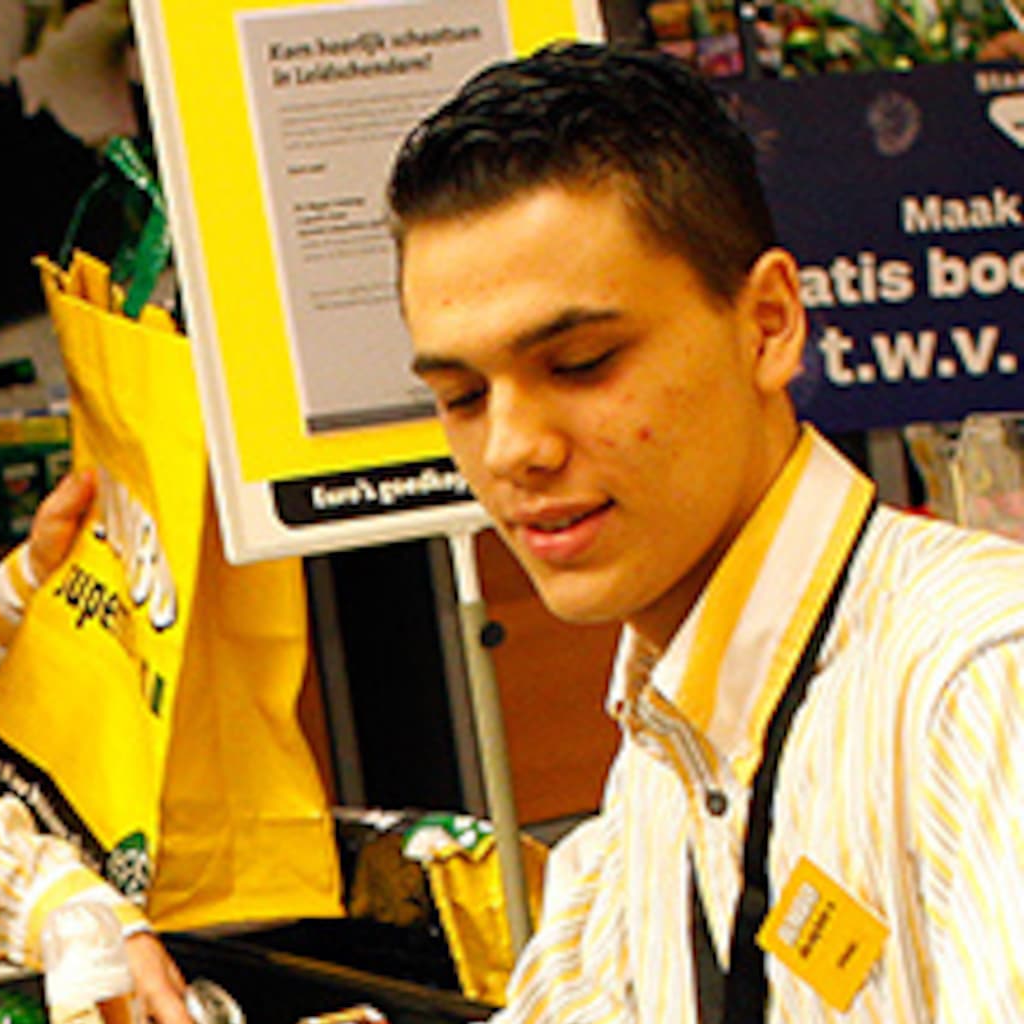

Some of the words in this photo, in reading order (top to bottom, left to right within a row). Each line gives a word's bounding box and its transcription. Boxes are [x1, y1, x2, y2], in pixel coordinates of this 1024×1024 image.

[901, 185, 1024, 235] Maak
[819, 324, 1019, 385] t.w.v.
[311, 476, 378, 511] Euro's
